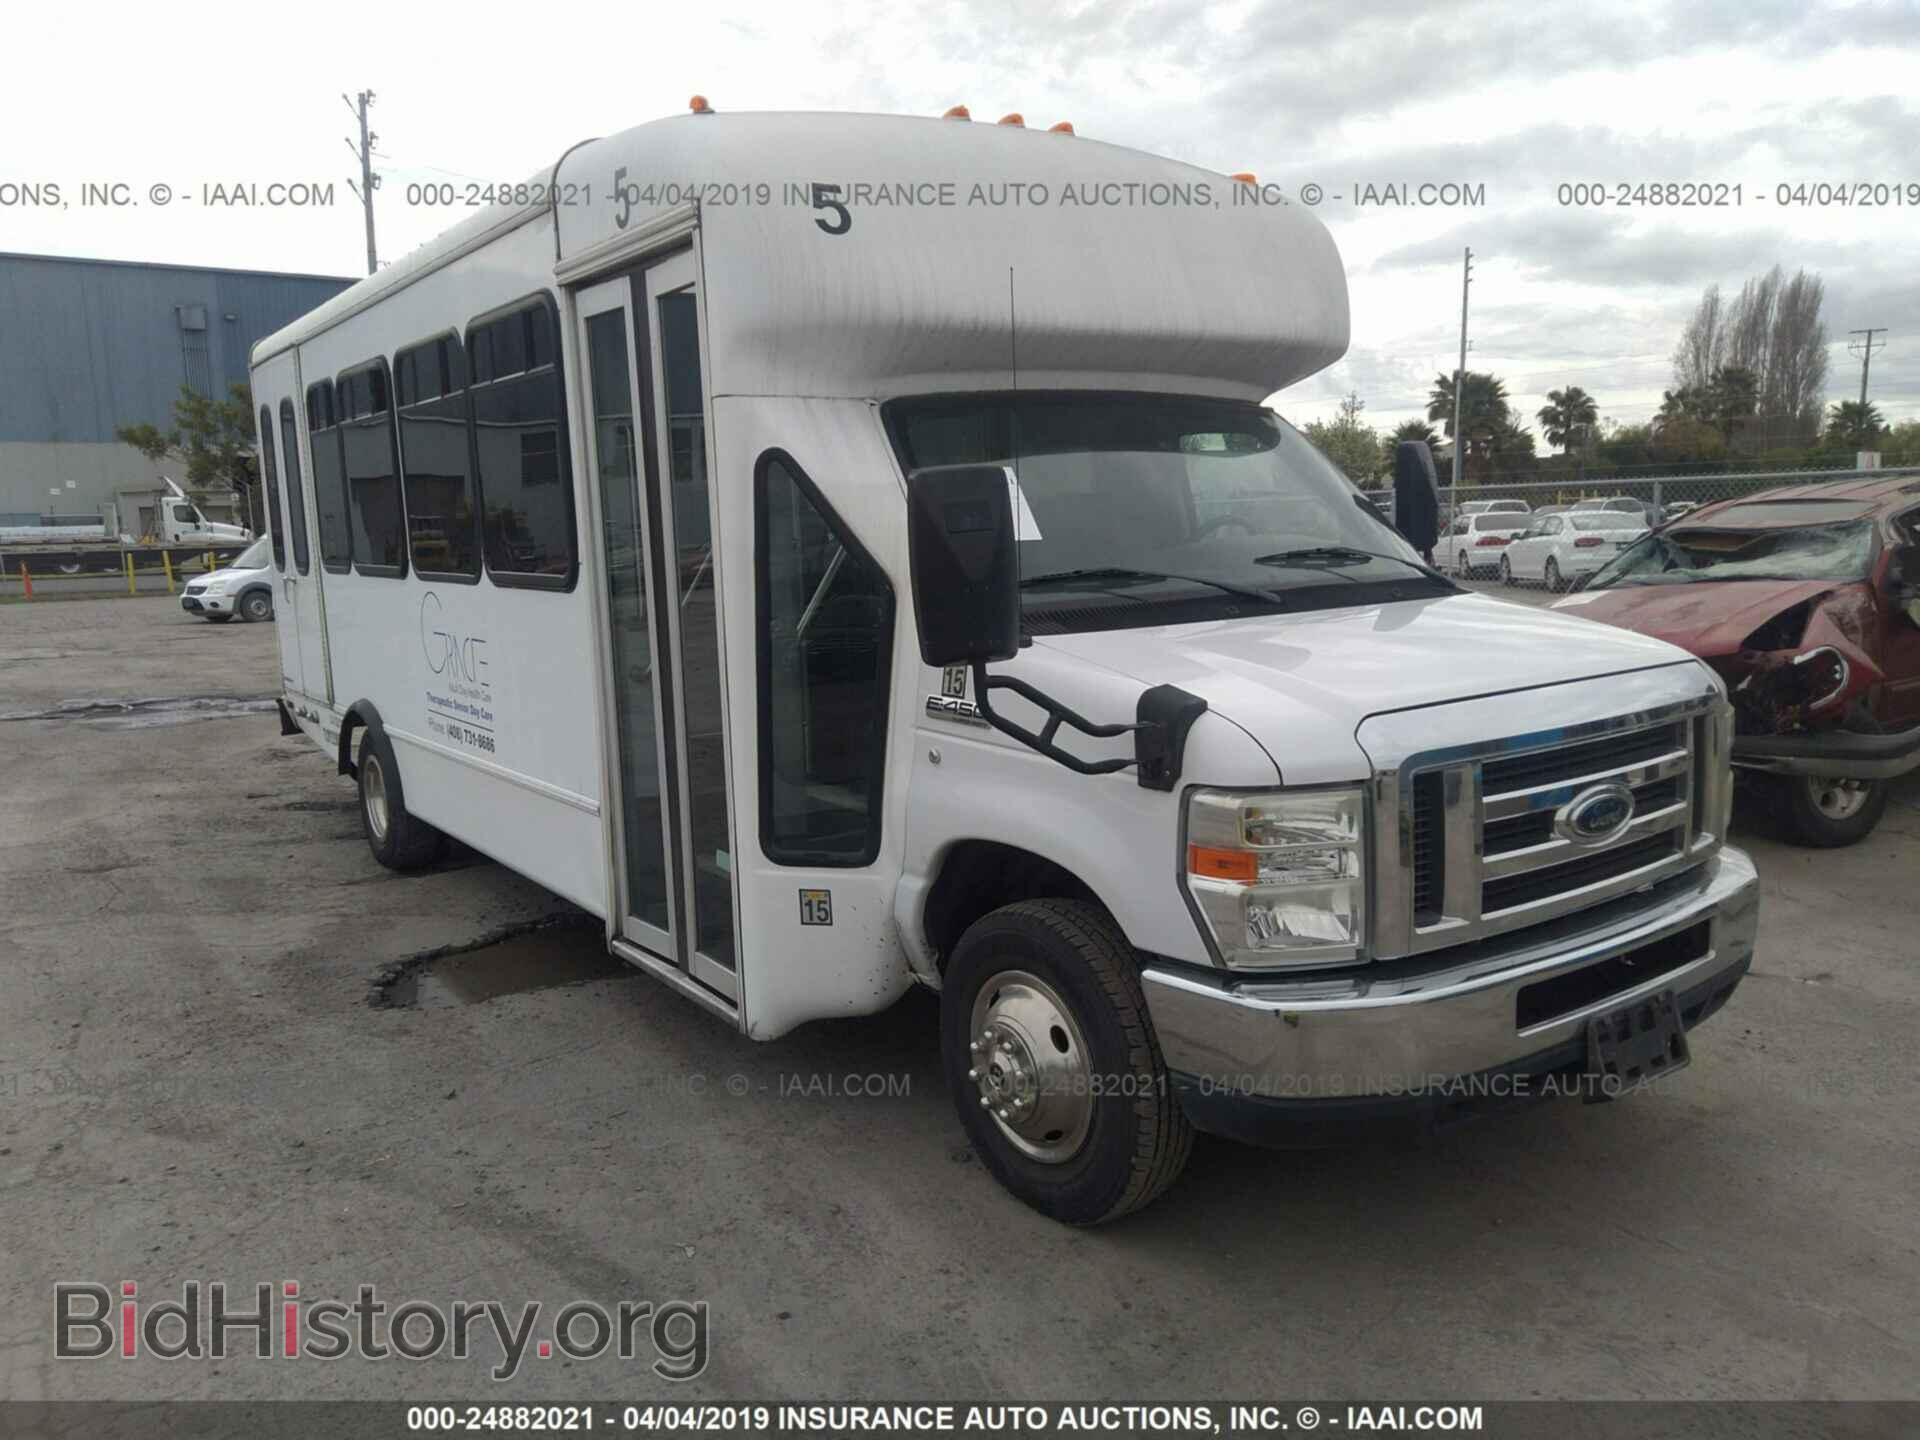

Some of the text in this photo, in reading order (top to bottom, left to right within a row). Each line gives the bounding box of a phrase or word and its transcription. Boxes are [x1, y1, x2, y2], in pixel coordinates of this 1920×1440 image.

[614, 166, 631, 230] 5
[811, 182, 852, 235] 5
[804, 899, 830, 922] 15
